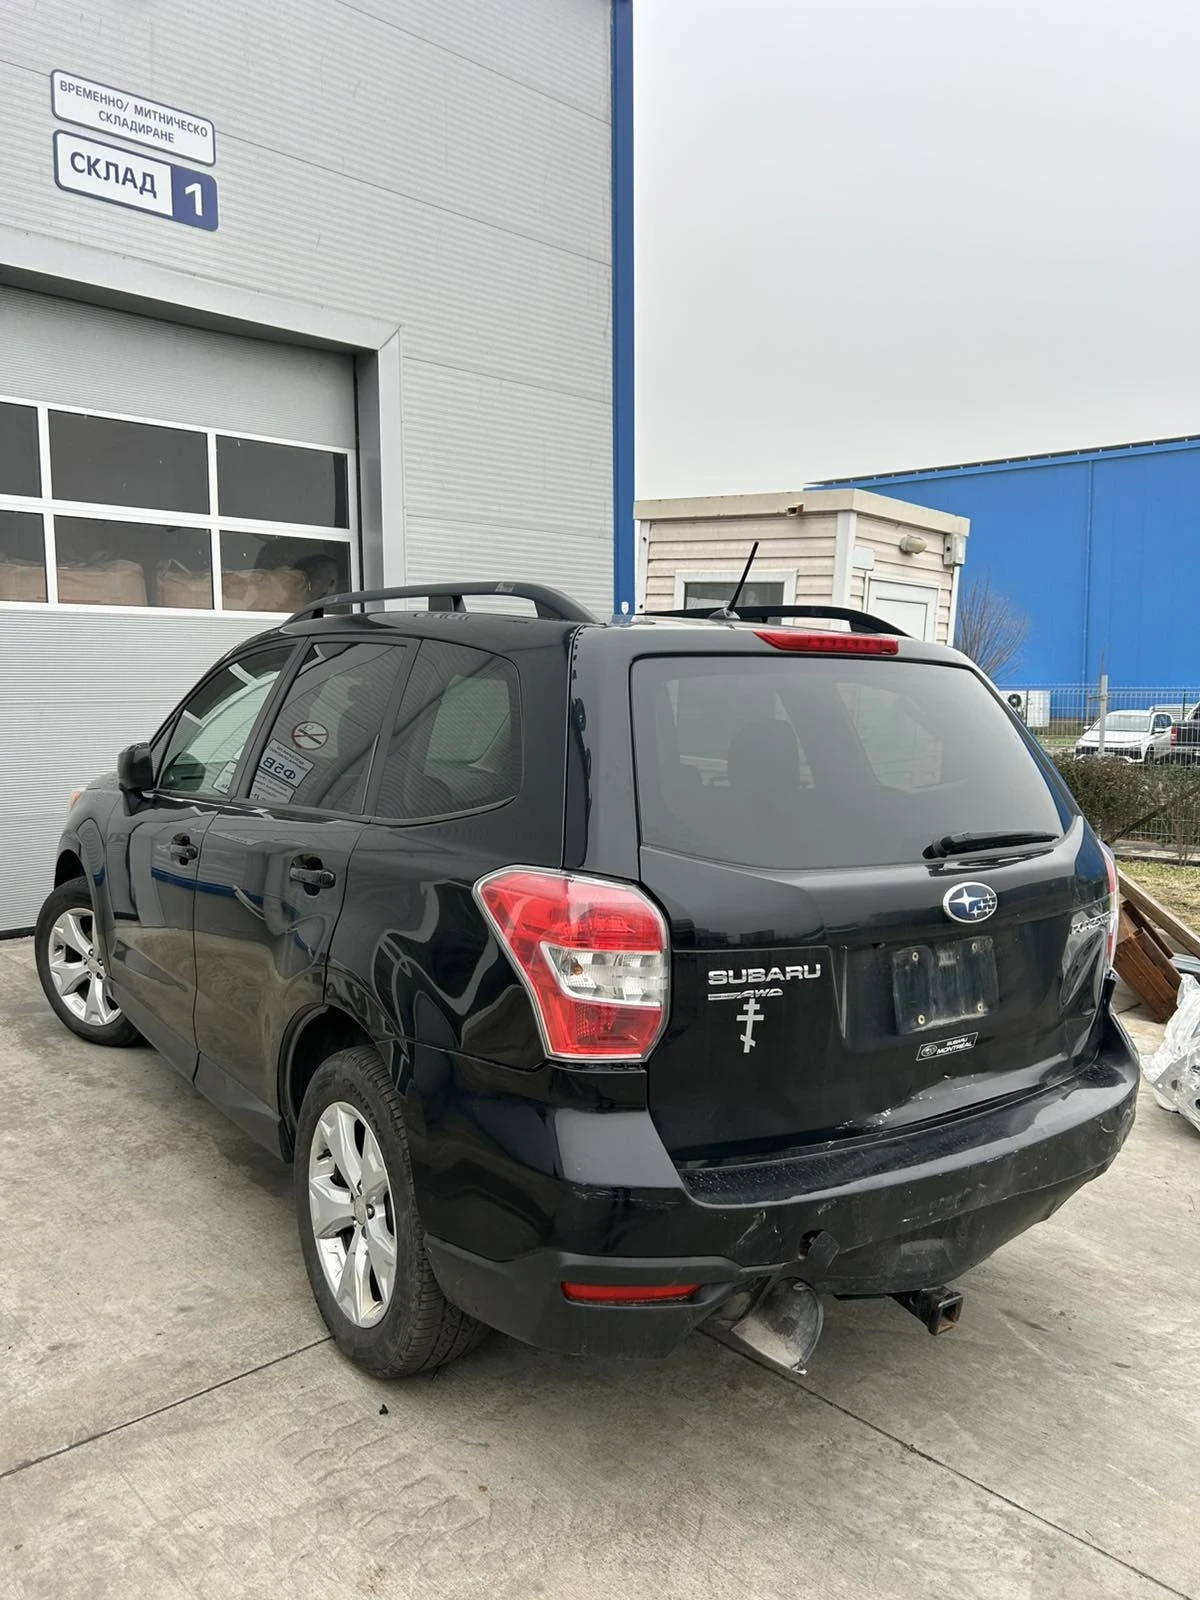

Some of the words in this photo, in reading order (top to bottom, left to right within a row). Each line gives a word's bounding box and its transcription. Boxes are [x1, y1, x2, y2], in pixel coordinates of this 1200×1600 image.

[59, 79, 130, 112] ВРЕМЕННО/
[134, 104, 208, 138] МИТНИЧЕСКО
[98, 110, 175, 143] СКЛАДИРАНЕ
[70, 151, 157, 199] СКЛАД
[184, 182, 203, 217] 1
[708, 963, 821, 985] SUBARU
[736, 988, 783, 999] AWD
